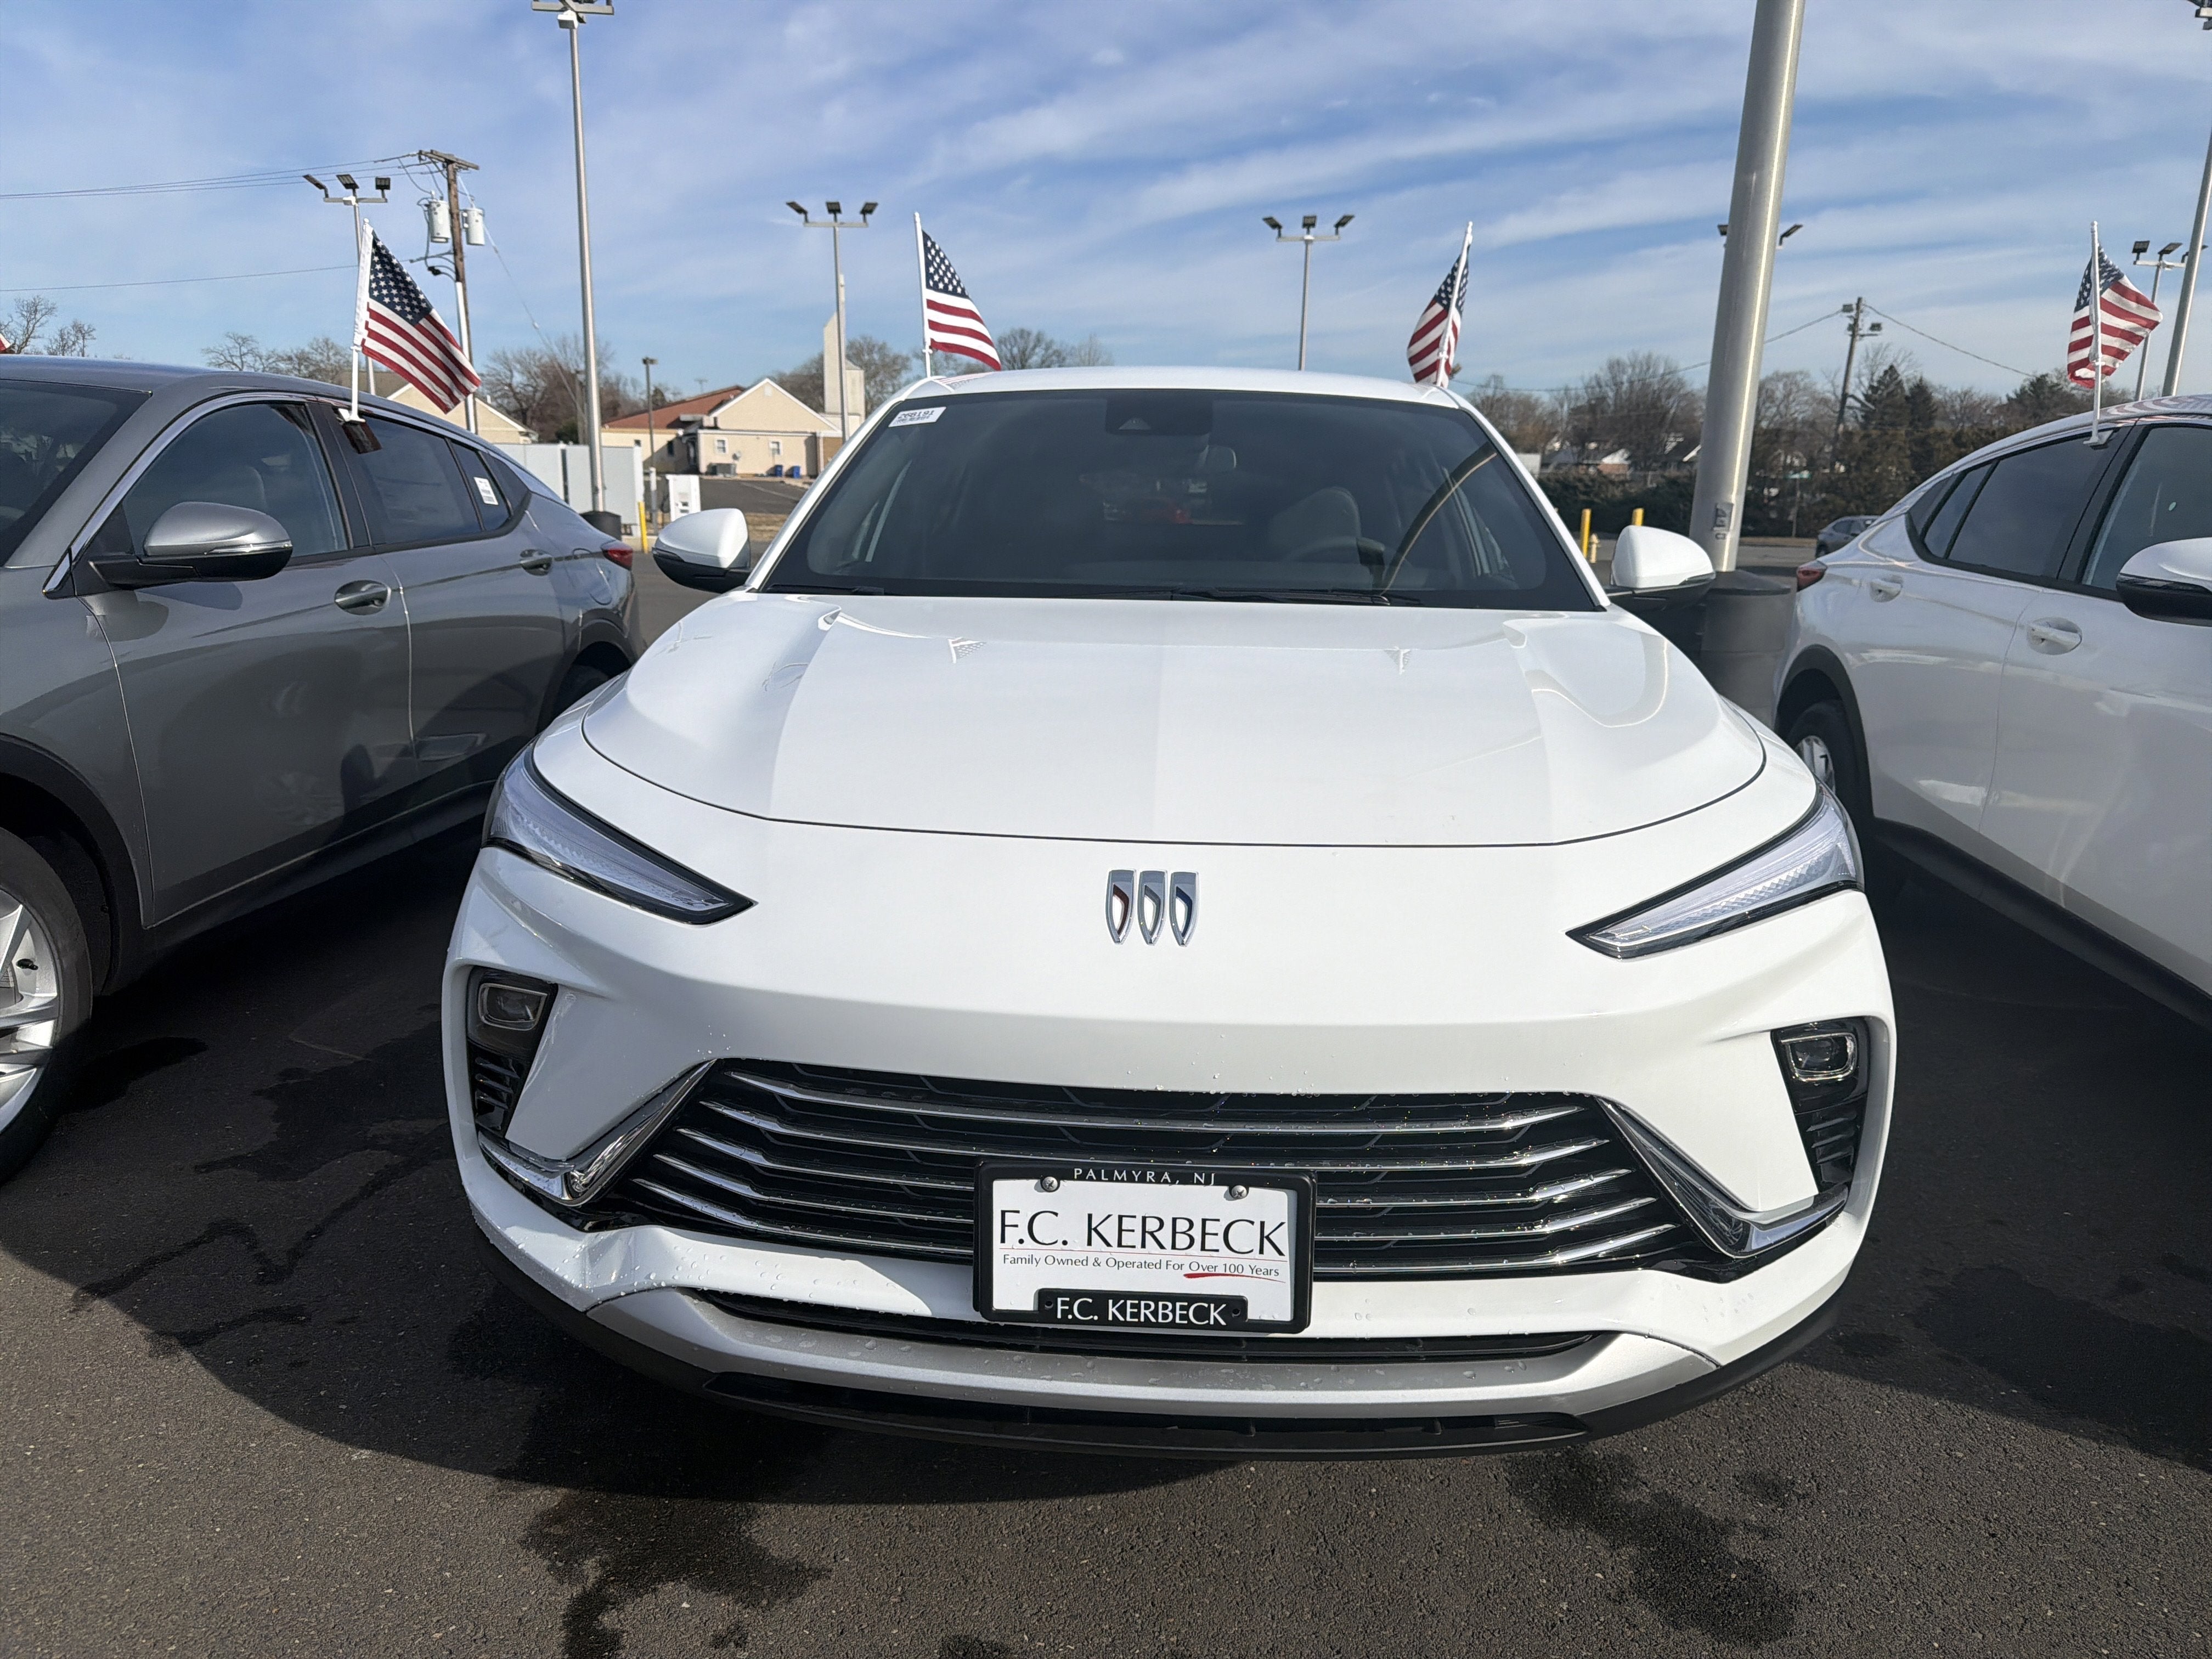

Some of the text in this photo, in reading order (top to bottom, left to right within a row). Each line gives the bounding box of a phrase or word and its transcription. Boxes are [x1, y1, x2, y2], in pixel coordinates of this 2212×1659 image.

[1074, 1168, 1216, 1186] PALMYRA, NJ
[1000, 1210, 1286, 1256] F.C. KERBECK
[1003, 1254, 1279, 1277] Family Owned & Operated For Over 100 Years
[1056, 1297, 1227, 1325] F.C. KERBECK
